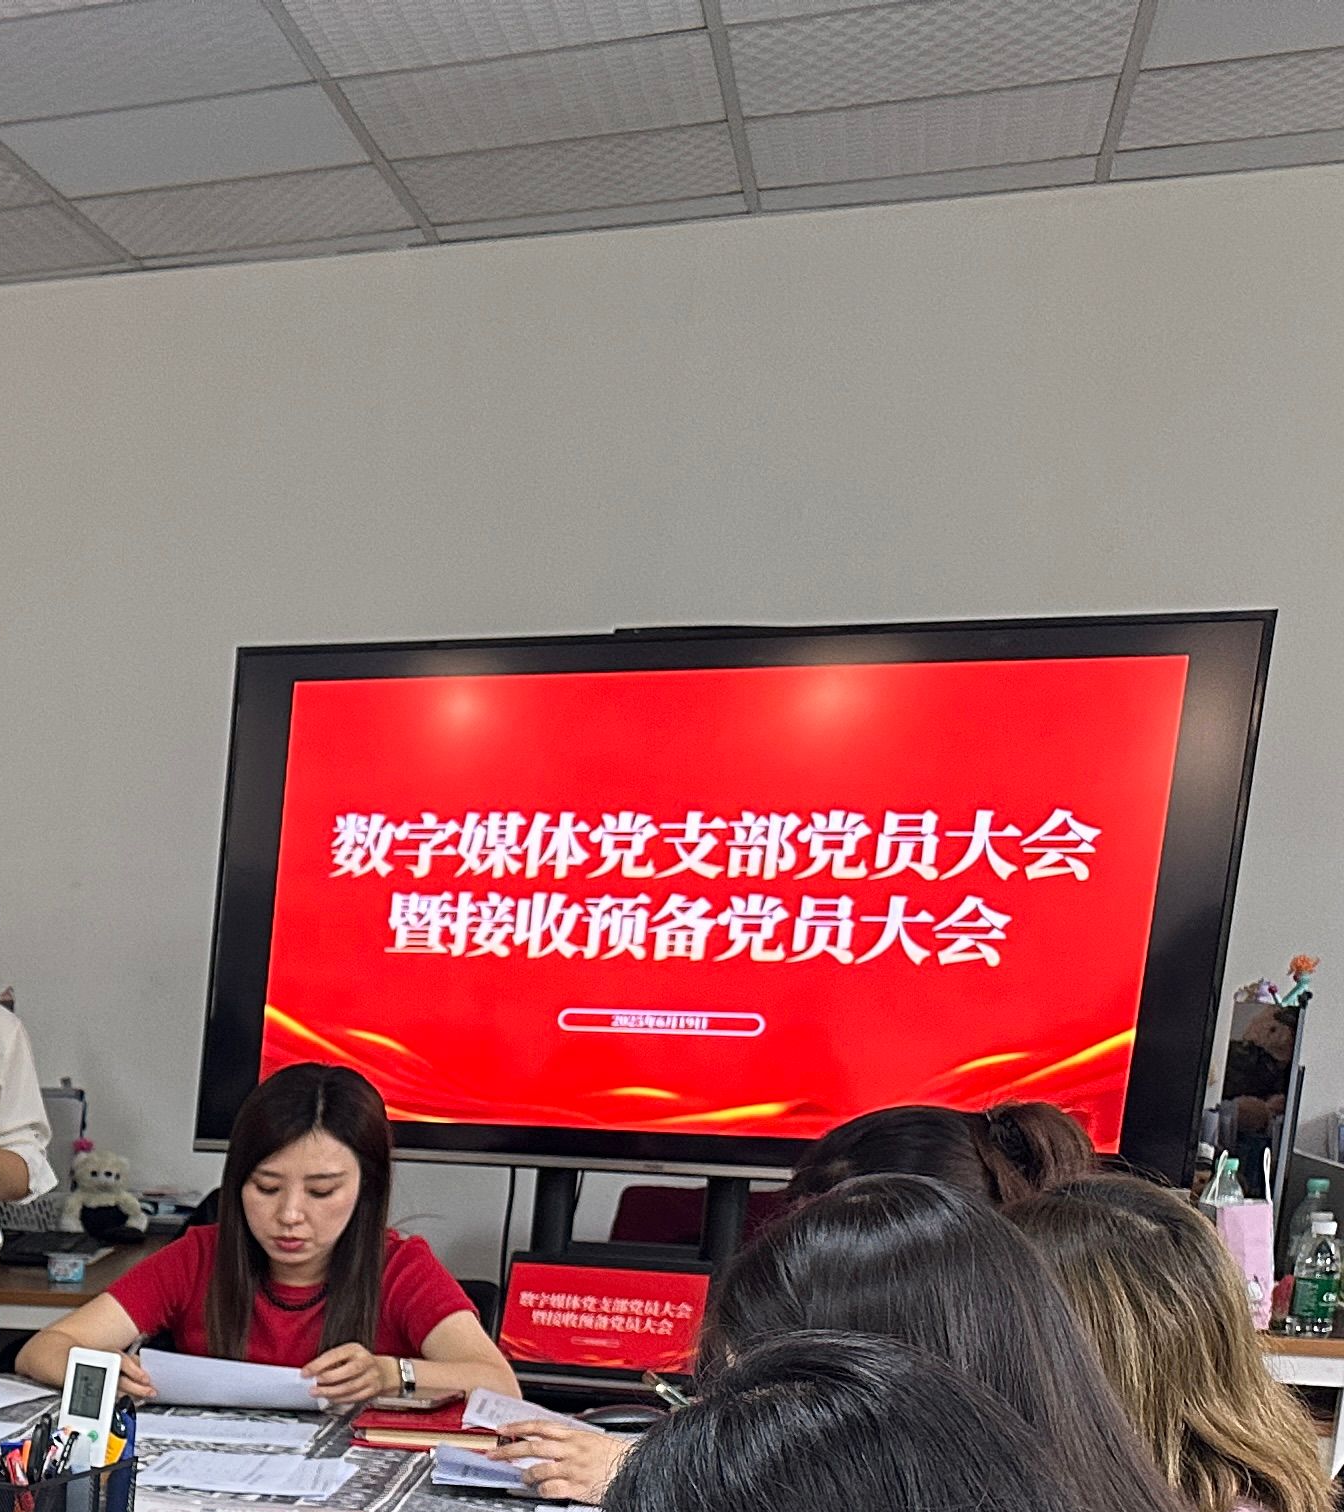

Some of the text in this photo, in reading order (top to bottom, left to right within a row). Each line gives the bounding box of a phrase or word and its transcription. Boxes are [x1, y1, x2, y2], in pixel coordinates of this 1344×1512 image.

[328, 807, 1104, 884] 数字媒体党支部党员大会
[385, 890, 1012, 968] 暨接收预备党员大会
[519, 1291, 693, 1319] 数字媒体党支部党员大会
[532, 1310, 674, 1335] 暨接收预备党员大会
